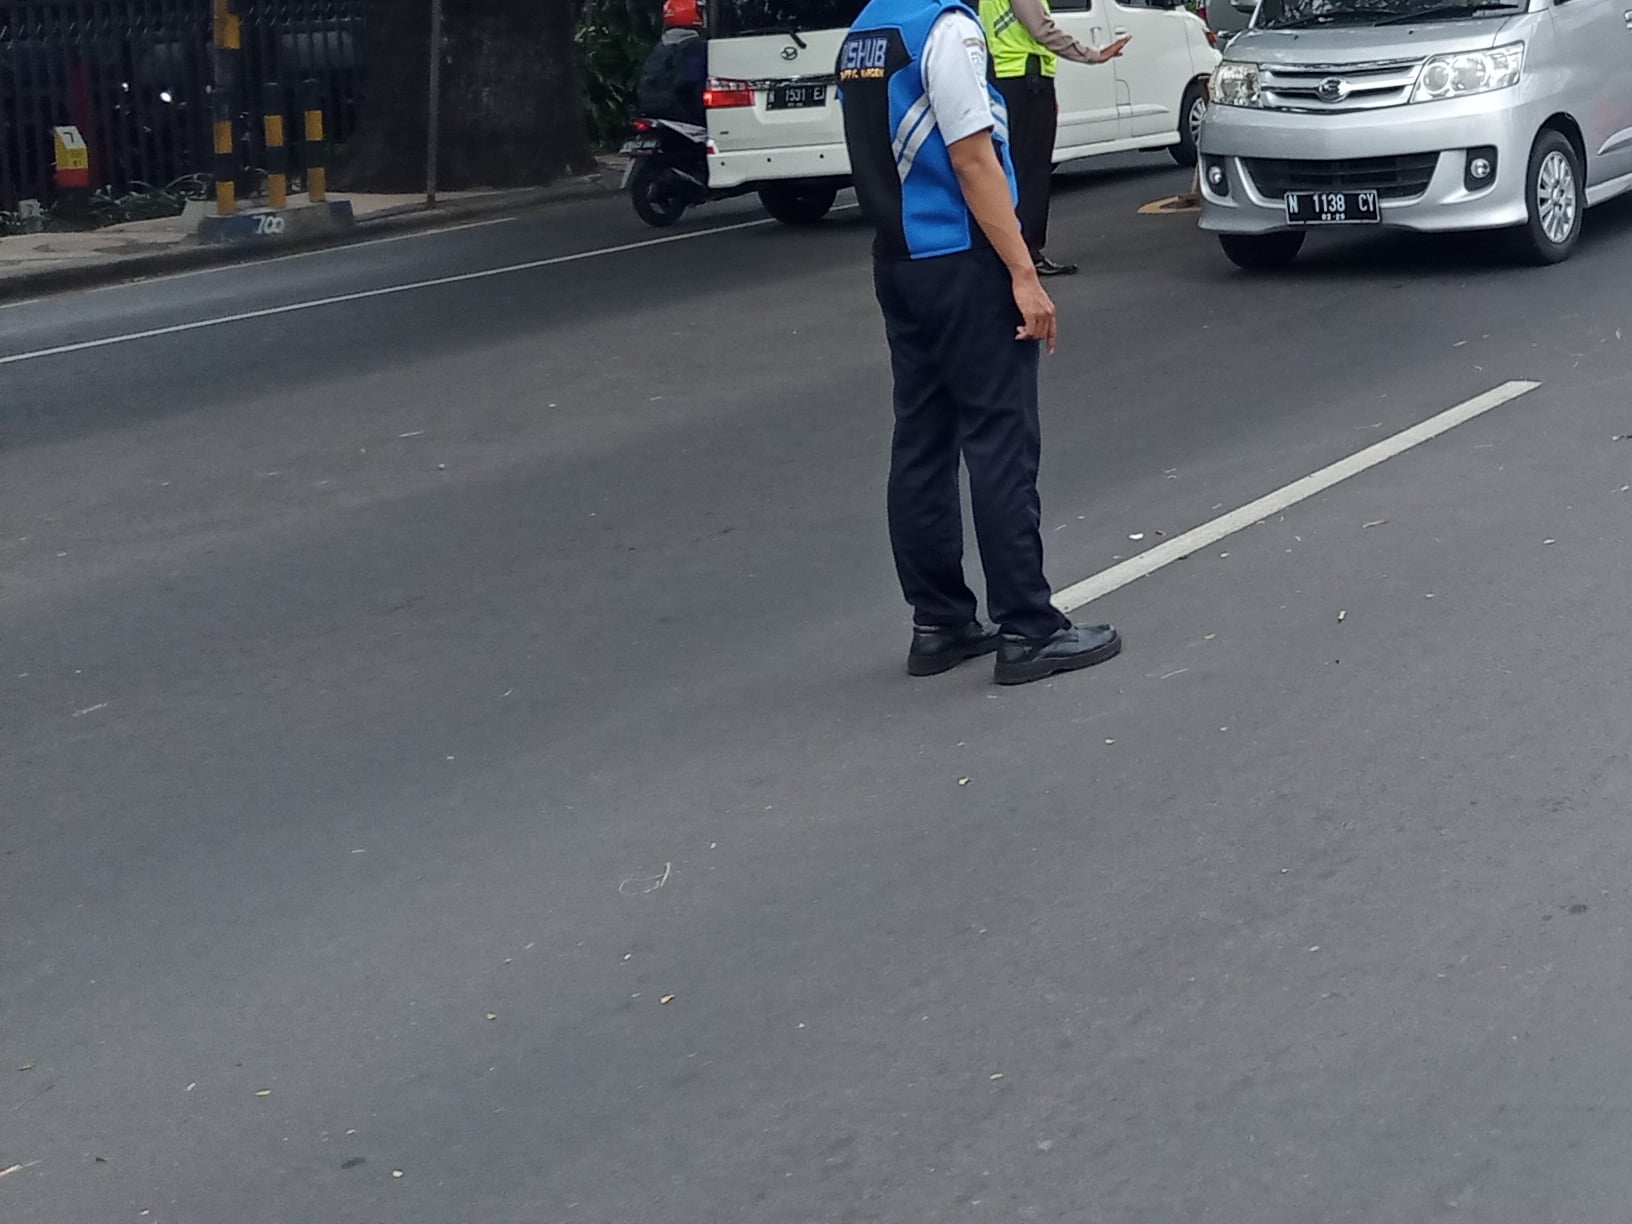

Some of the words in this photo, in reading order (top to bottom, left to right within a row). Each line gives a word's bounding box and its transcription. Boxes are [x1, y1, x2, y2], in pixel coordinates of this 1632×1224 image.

[841, 37, 888, 69] ISHUB
[785, 87, 806, 102] 1531
[1288, 195, 1299, 213] N
[1312, 194, 1346, 213] 1138
[1358, 193, 1374, 212] CY
